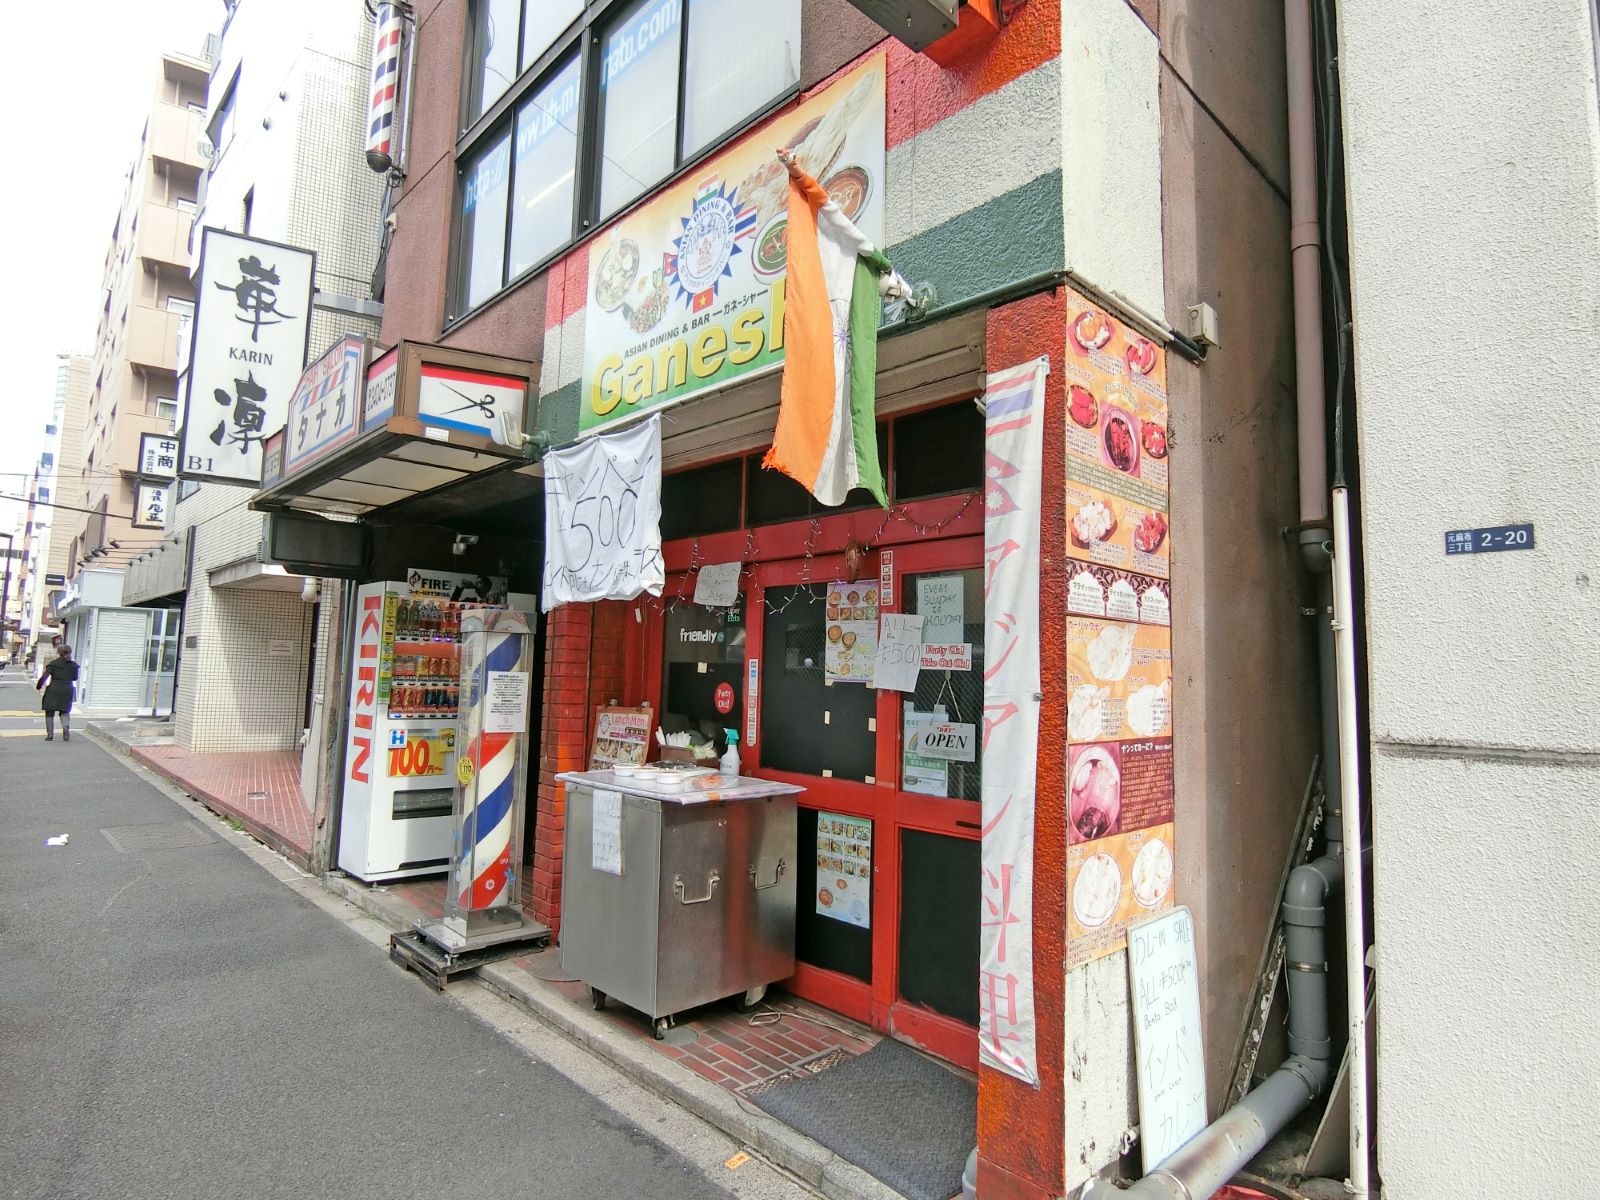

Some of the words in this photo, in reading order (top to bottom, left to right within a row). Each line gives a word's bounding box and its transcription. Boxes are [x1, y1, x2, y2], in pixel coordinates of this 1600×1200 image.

[624, 342, 647, 359] ASIAN
[649, 330, 679, 349] DINING
[681, 322, 689, 333] &
[692, 315, 710, 330] BAR
[229, 347, 273, 366] KARIN
[298, 388, 346, 451] タナカ
[188, 456, 214, 472] B1
[1448, 533, 1472, 542] 元麻布
[1481, 530, 1527, 547] 2-20
[421, 578, 452, 590] FIRE
[924, 595, 956, 606] SUNDAY
[680, 628, 717, 643] friendly
[926, 645, 947, 656] Party
[351, 596, 382, 784] KIRIN
[925, 733, 968, 749] OPEN
[1140, 976, 1160, 1010] ALL
